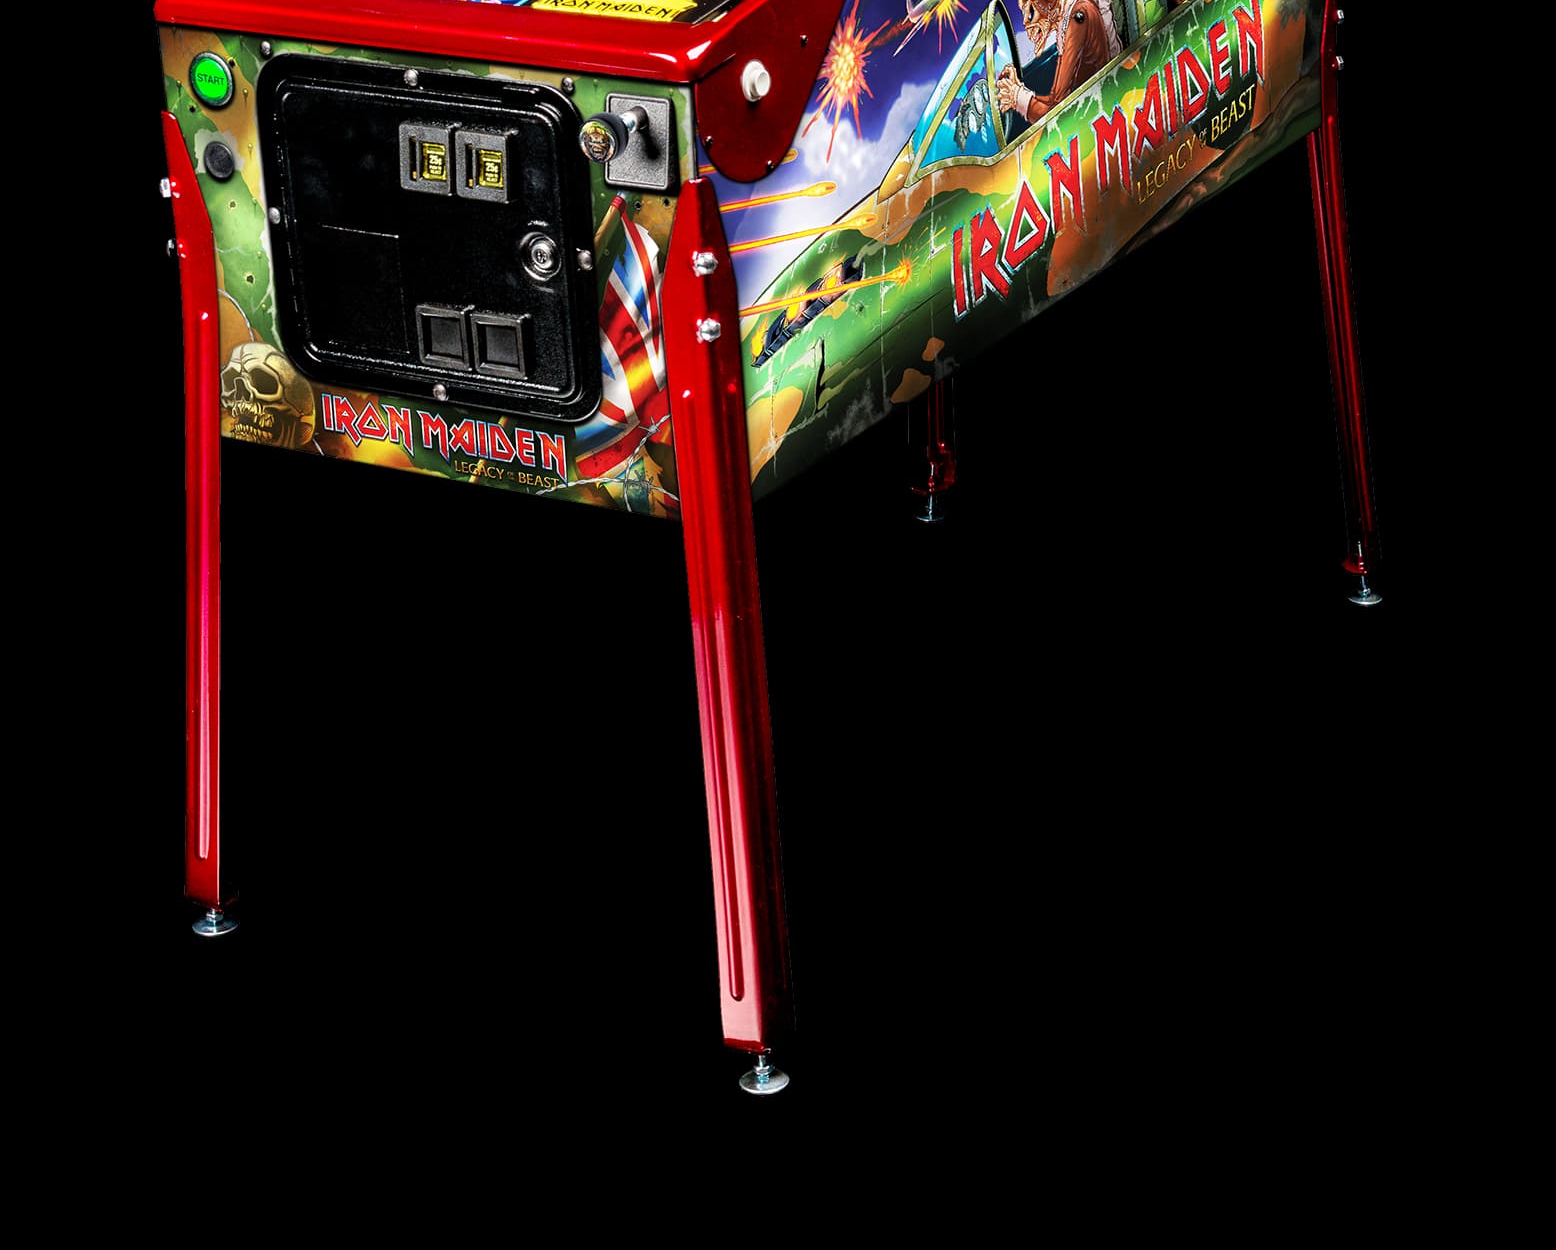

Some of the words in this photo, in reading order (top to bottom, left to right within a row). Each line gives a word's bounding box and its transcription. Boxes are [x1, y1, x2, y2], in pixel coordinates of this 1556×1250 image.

[598, 1, 674, 19] MAIDEN
[197, 72, 225, 87] START
[1136, 133, 1197, 205] LEGACY
[1210, 83, 1256, 143] BEAST
[951, 131, 1088, 322] IRON
[321, 392, 415, 458] IRON
[417, 409, 569, 488] MAIDEN
[454, 459, 504, 480] LEGACY
[518, 471, 560, 489] BEAST
